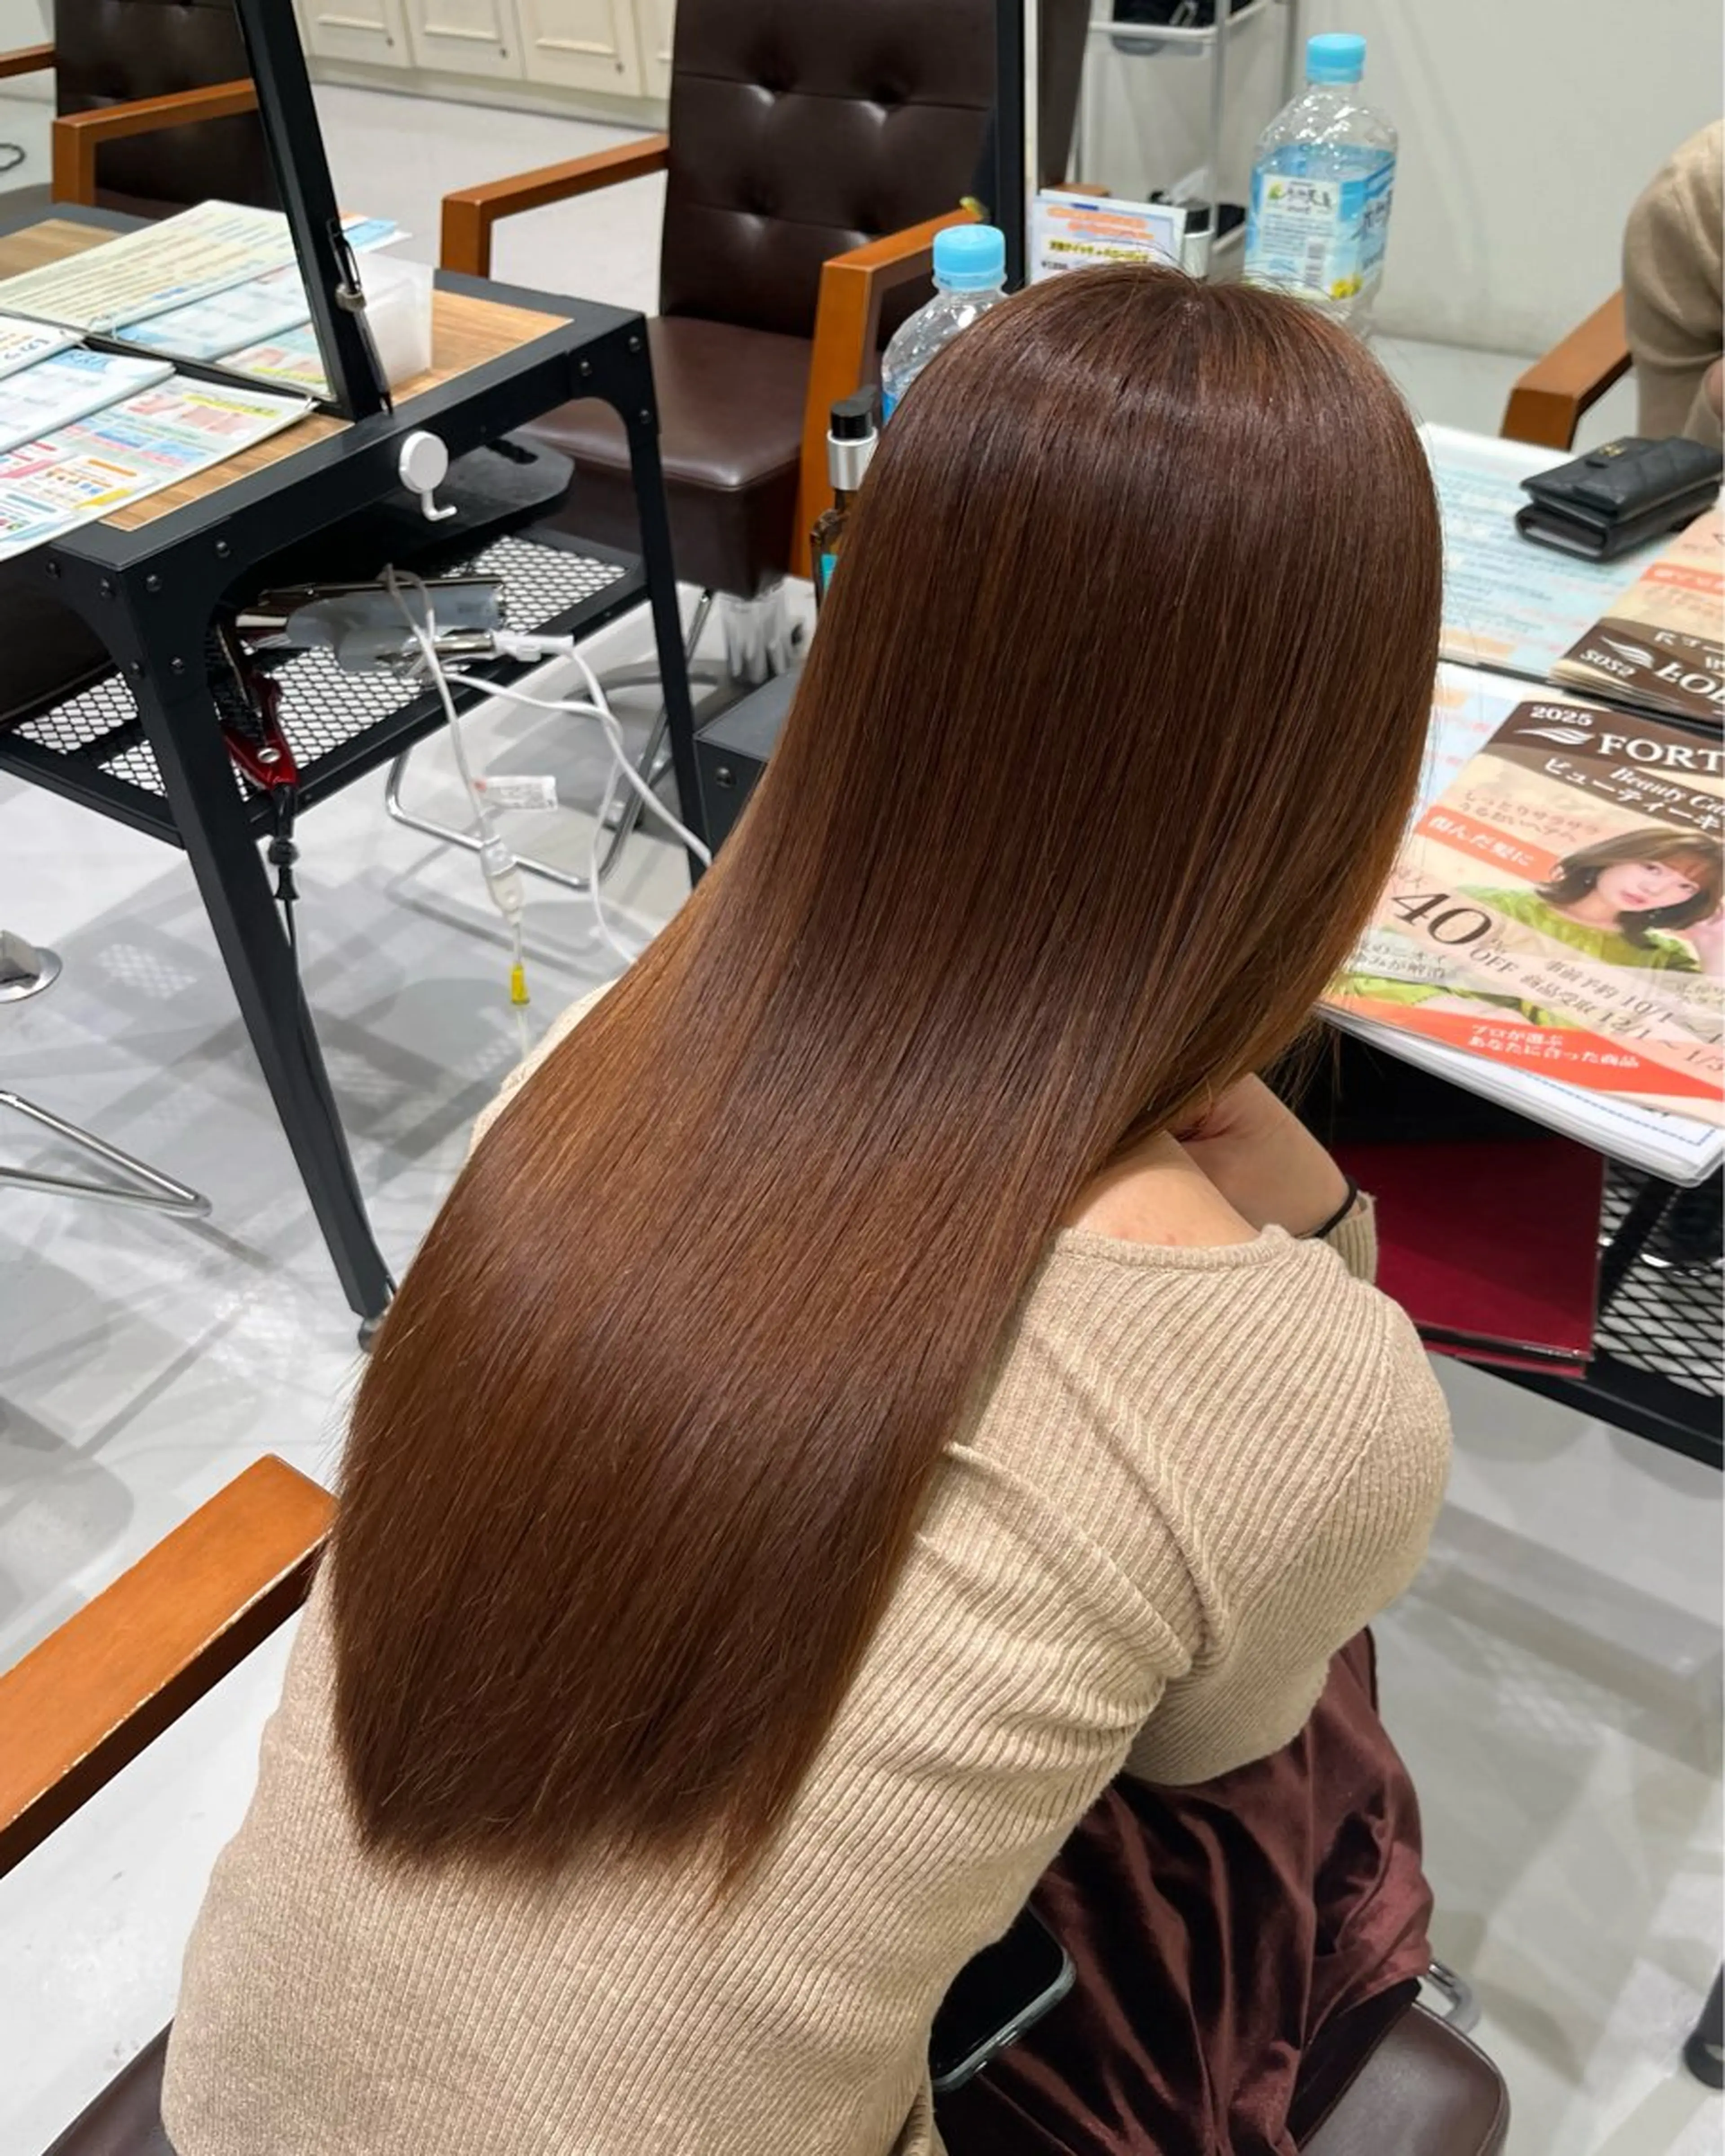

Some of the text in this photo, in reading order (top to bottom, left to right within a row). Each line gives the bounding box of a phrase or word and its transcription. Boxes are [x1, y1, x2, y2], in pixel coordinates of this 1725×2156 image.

[1530, 705, 1595, 727] 2025
[1597, 732, 1725, 772] FORT
[1391, 893, 1492, 945] 40
[1470, 947, 1519, 974] OFF
